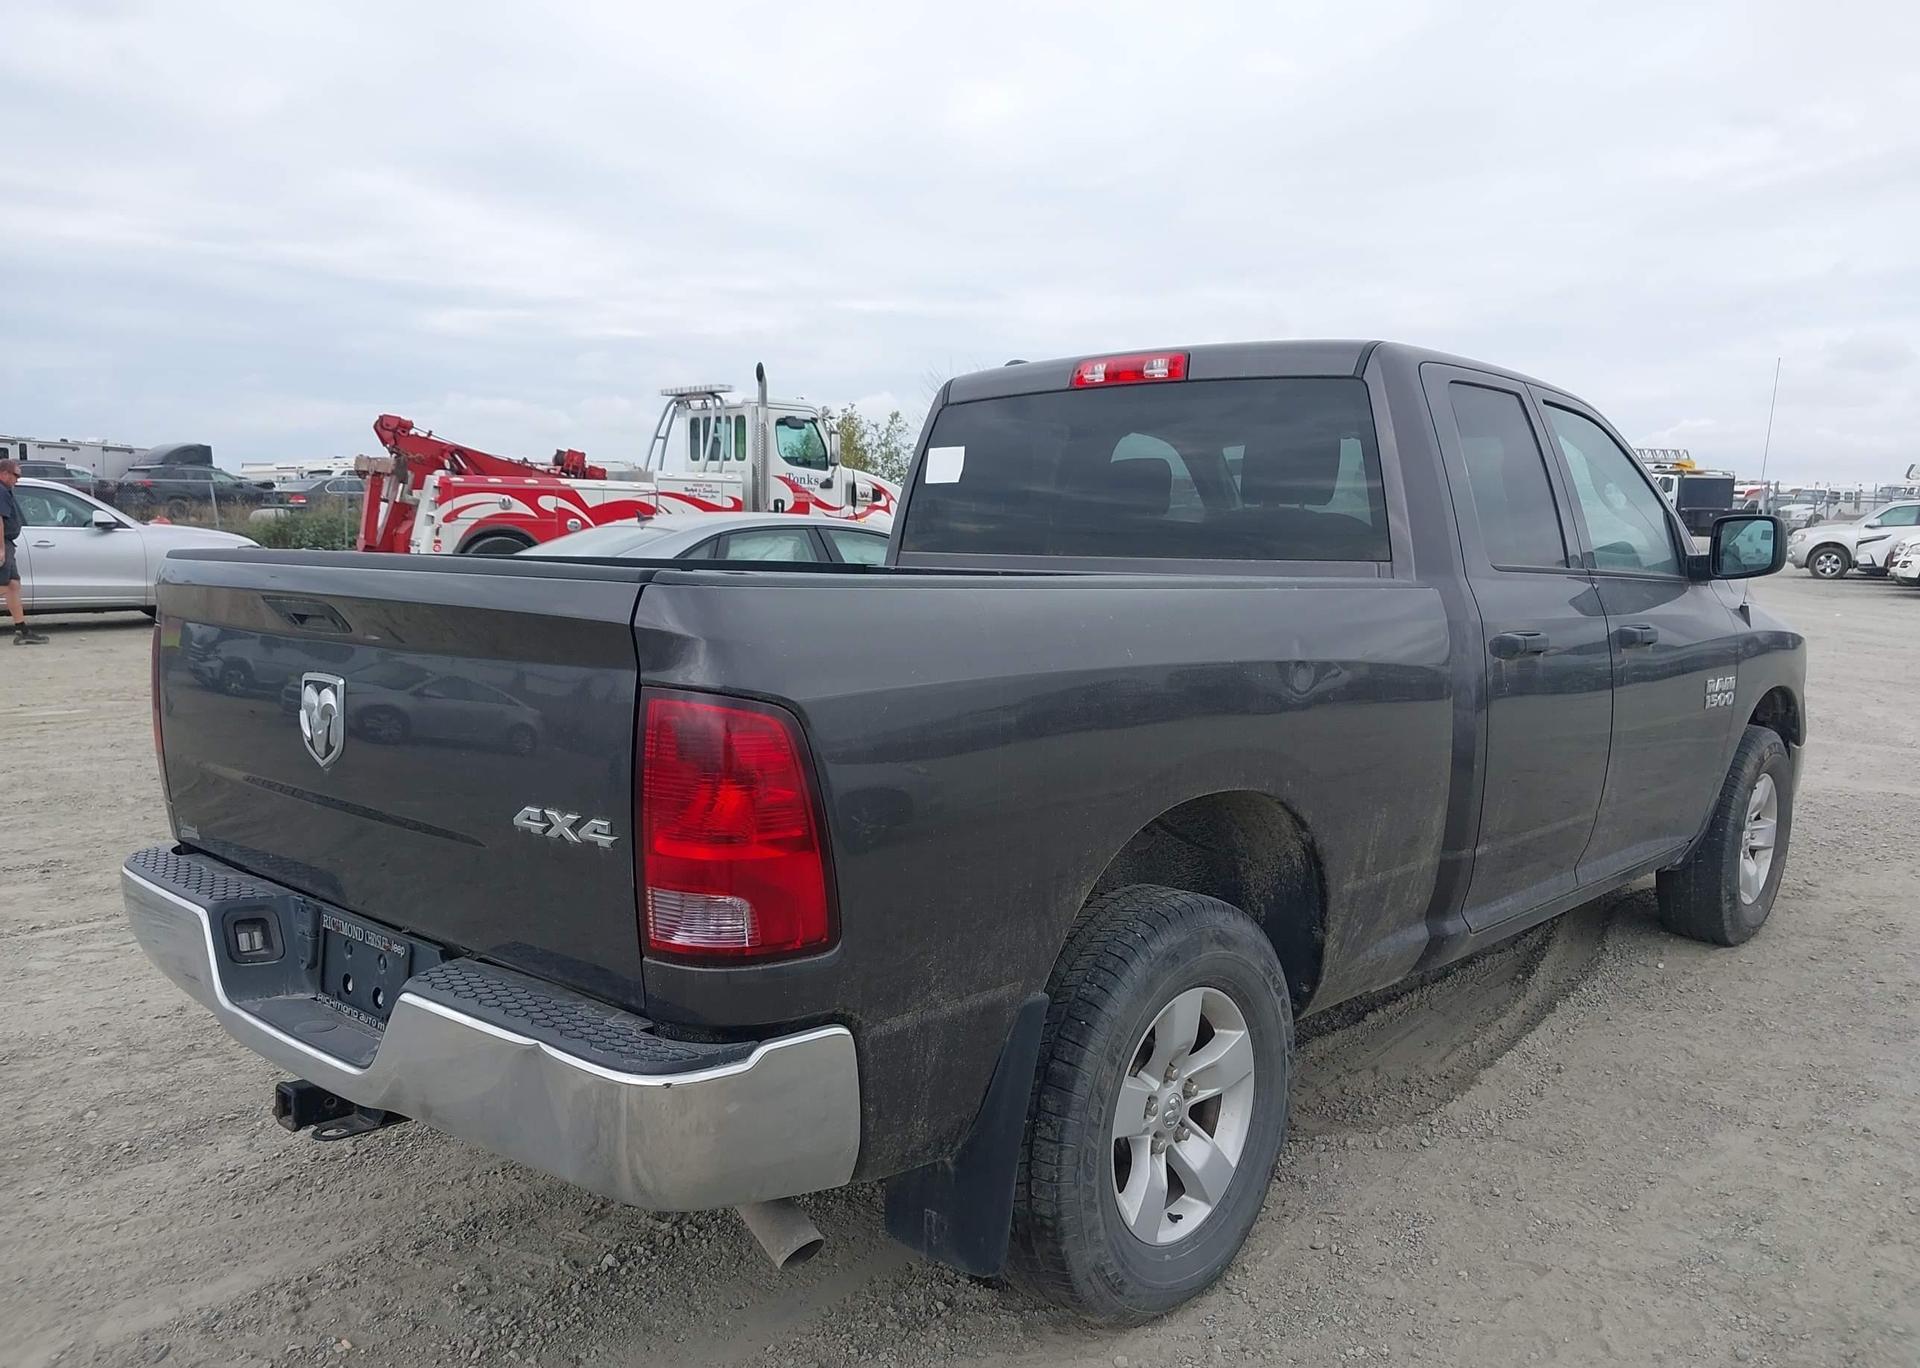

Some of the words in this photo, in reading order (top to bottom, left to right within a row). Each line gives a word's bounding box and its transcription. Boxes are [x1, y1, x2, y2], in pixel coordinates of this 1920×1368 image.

[785, 472, 820, 486] Tonks
[1705, 691, 1735, 709] 1500
[513, 806, 620, 848] 4X4
[322, 913, 364, 942] RICHMOND
